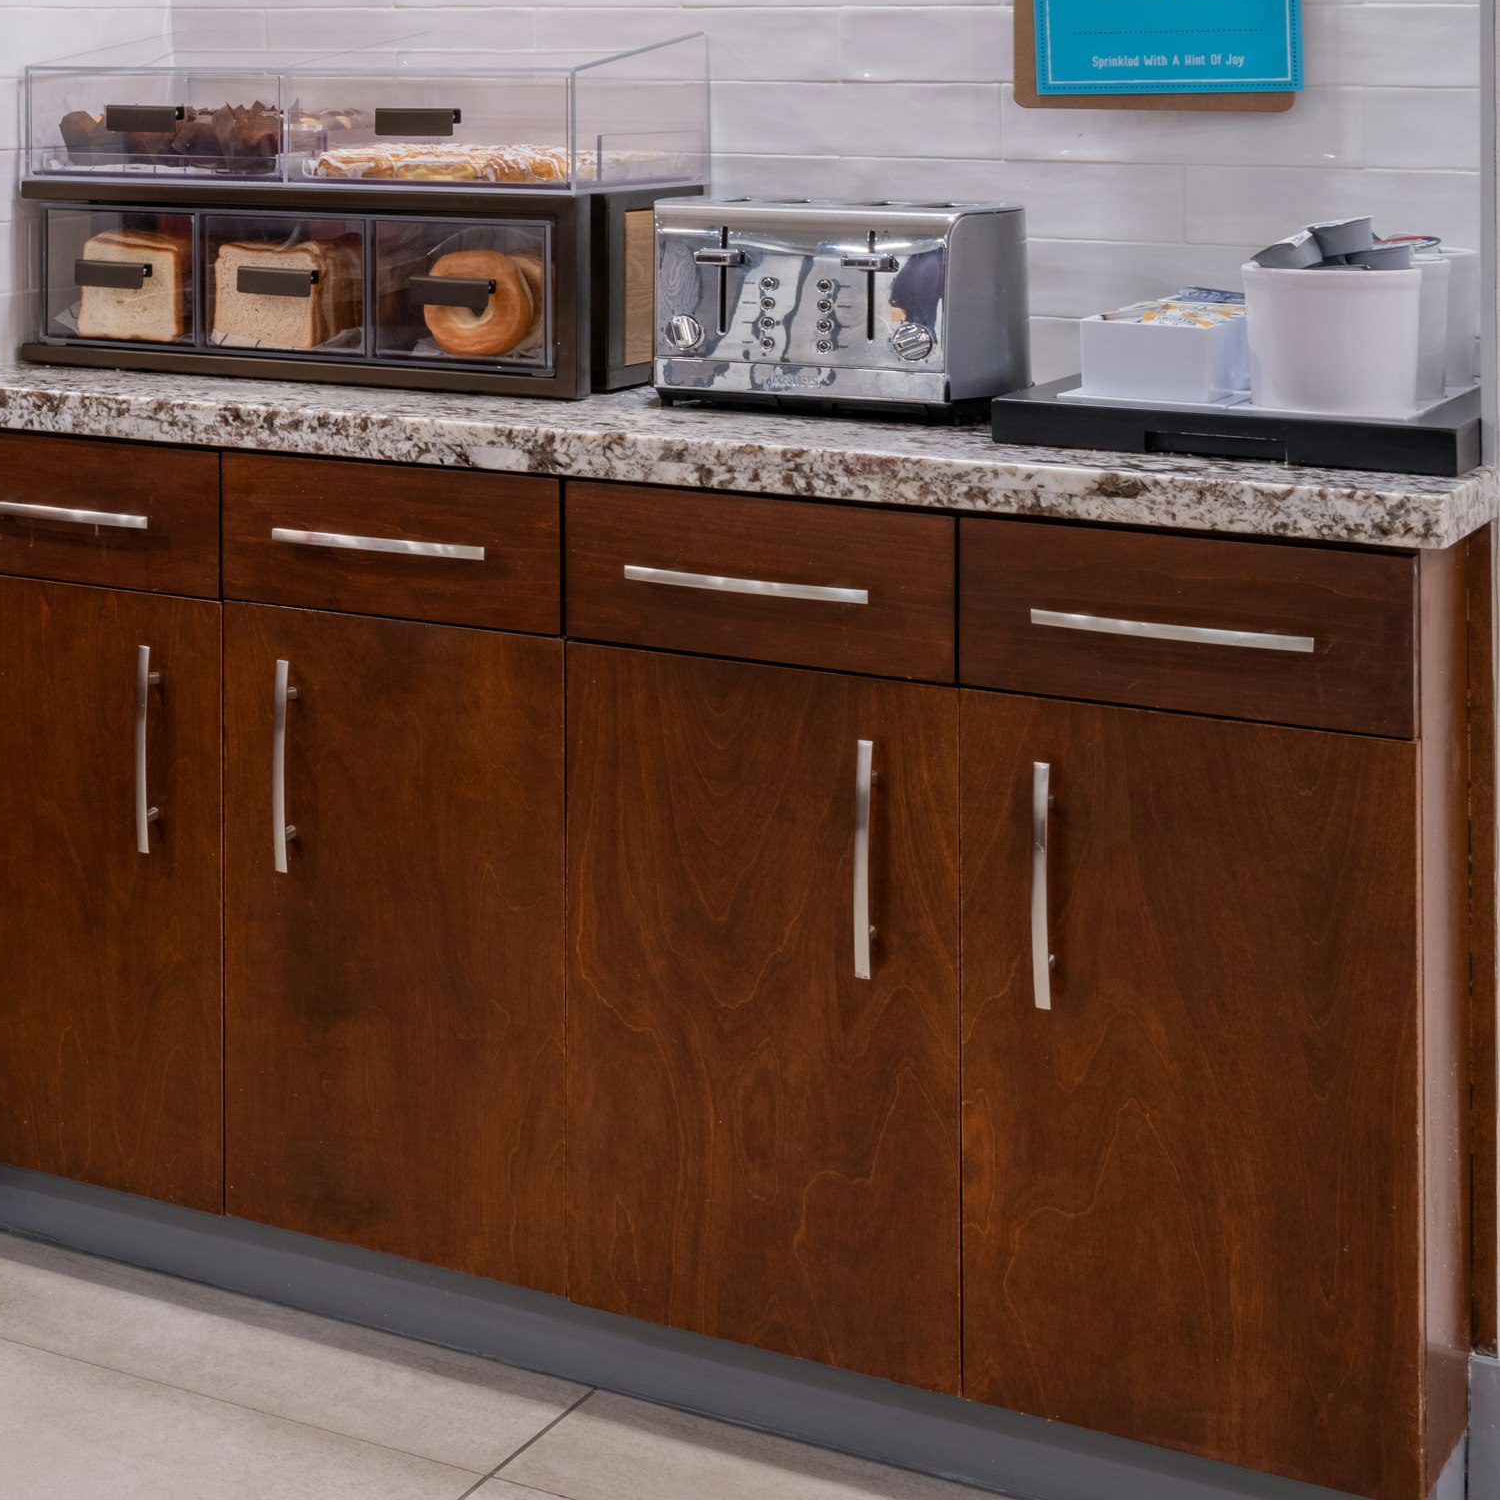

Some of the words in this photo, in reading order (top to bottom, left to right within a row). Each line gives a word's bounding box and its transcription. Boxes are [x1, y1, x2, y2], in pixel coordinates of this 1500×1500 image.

[1092, 54, 1139, 70] Sprinkled
[1144, 54, 1167, 67] With
[1173, 55, 1180, 66] A
[1185, 54, 1206, 66] Hint
[1211, 54, 1221, 65] Of
[1226, 54, 1244, 68] Joy
